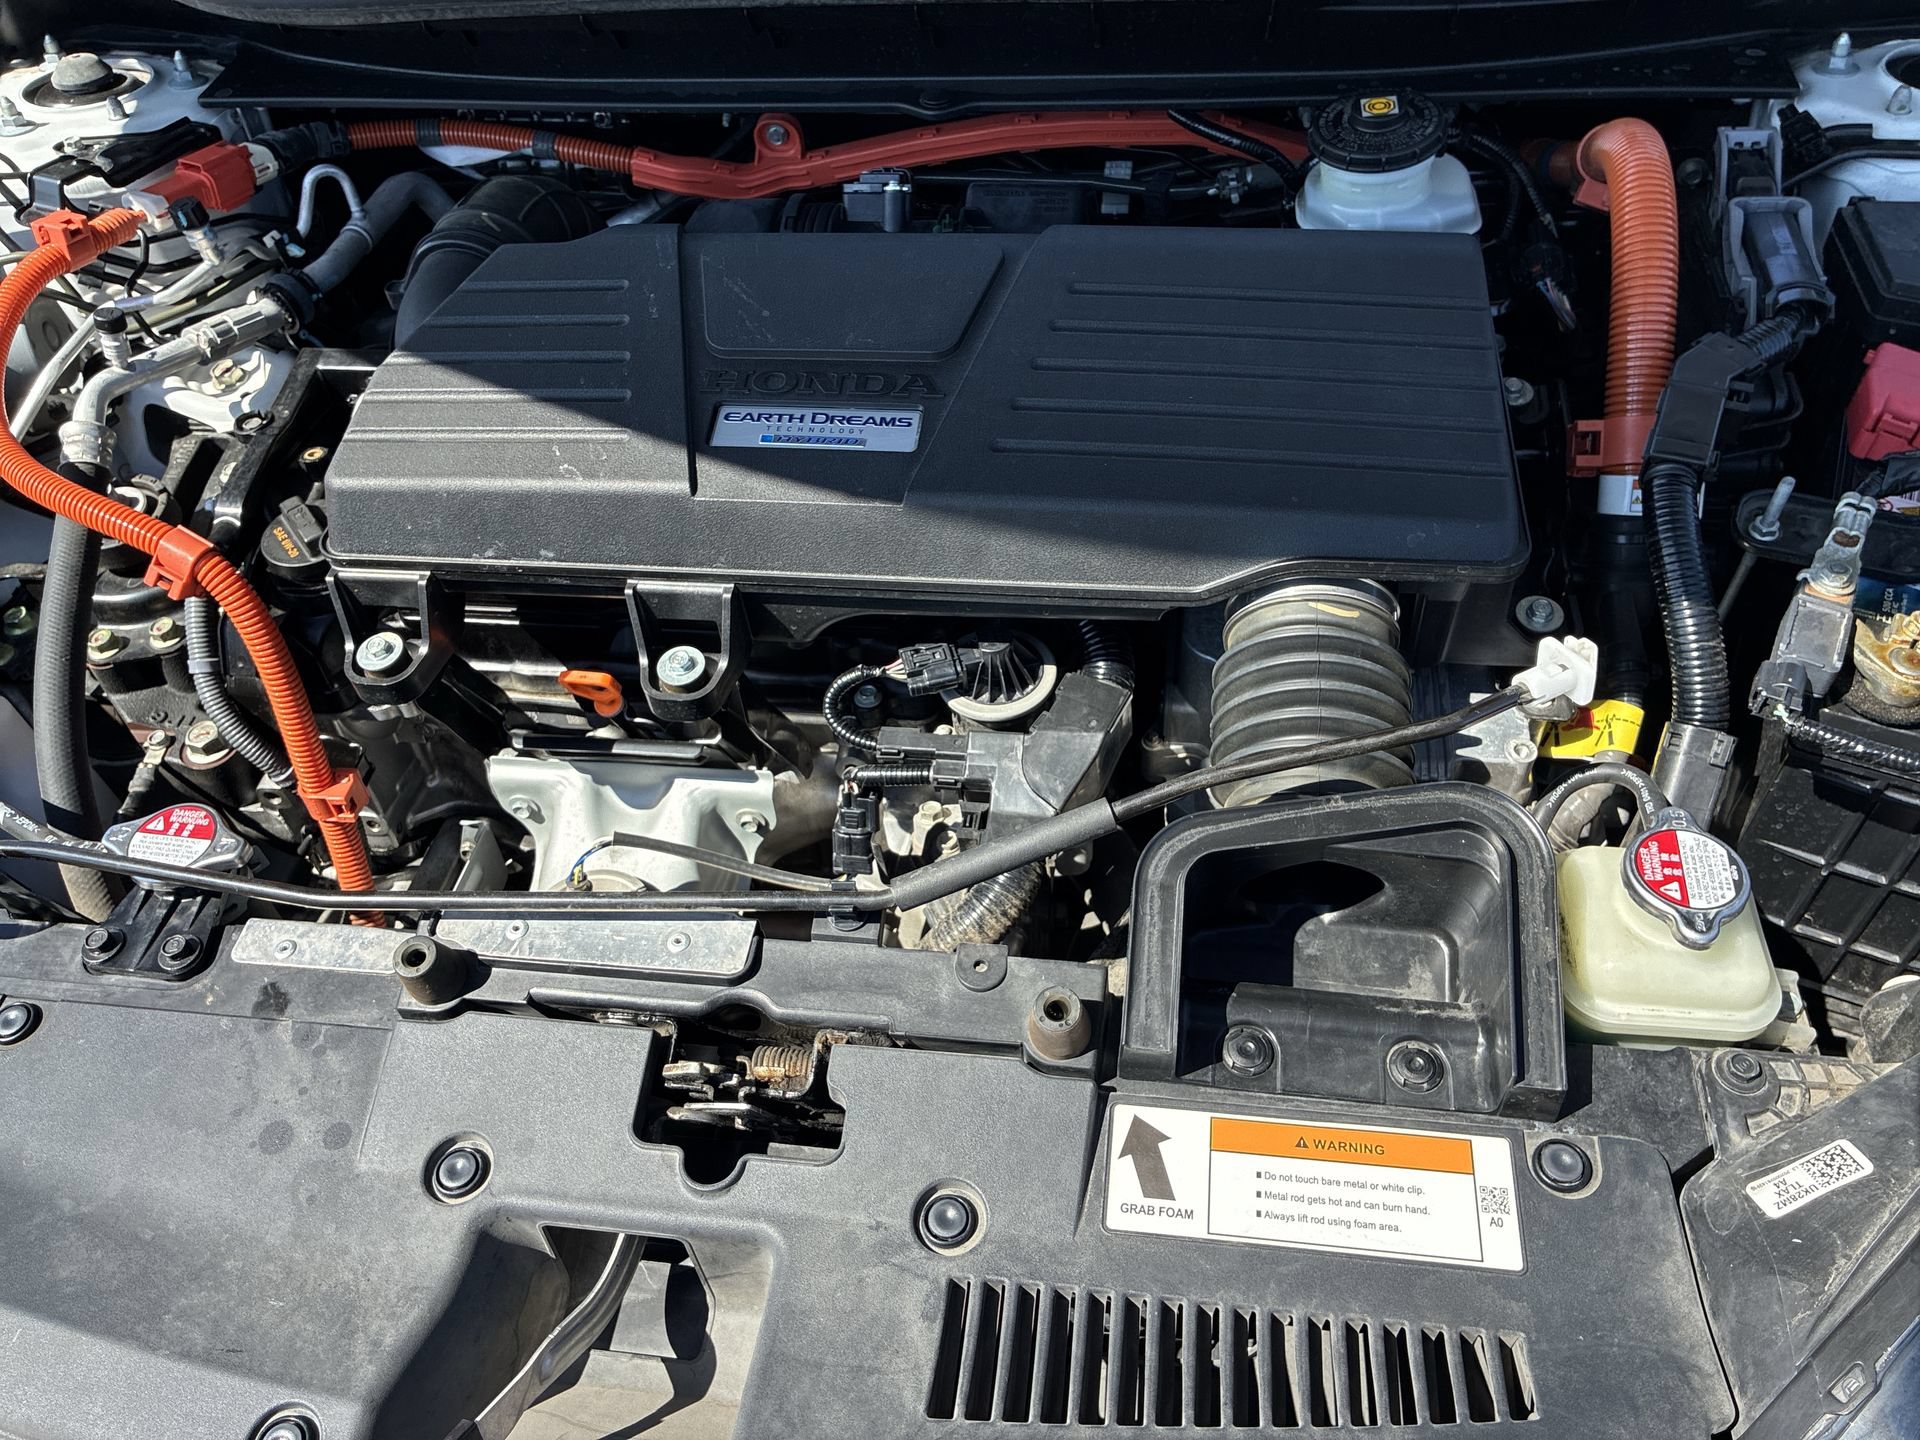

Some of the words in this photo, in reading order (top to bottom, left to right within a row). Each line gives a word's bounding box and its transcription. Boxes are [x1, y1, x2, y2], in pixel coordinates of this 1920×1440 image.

[700, 368, 945, 398] HONDA
[723, 411, 806, 424] EARTH
[811, 412, 913, 428] DREAMS
[766, 425, 865, 435] TECHNOLOGY
[775, 435, 863, 445] HYBRID
[174, 808, 208, 819] DANGER
[1669, 809, 1687, 828] 0.5
[1640, 847, 1654, 881] DANGER
[1648, 841, 1664, 881] WARNUNG
[1313, 1138, 1385, 1155] WARNING
[1264, 1172, 1276, 1180] Do
[1279, 1174, 1293, 1182] not
[1295, 1175, 1319, 1184] touch
[1321, 1177, 1341, 1186] bare
[1344, 1181, 1367, 1189] metal
[1381, 1184, 1404, 1192] white
[1407, 1185, 1425, 1195] clip.
[1773, 1177, 1787, 1190] A4
[1774, 1181, 1804, 1198] TLAX
[1120, 1203, 1155, 1215] GRAB
[1159, 1206, 1193, 1220] FOAM
[1264, 1191, 1288, 1201] Metal
[1291, 1194, 1305, 1202] rod
[1307, 1196, 1326, 1205] gets
[1329, 1196, 1342, 1206] hot
[1345, 1200, 1361, 1208] and
[1364, 1202, 1380, 1210] can
[1383, 1202, 1402, 1212] burn
[1405, 1204, 1430, 1215] hand.
[1264, 1210, 1295, 1223] Always
[1298, 1213, 1308, 1223] lift
[1311, 1216, 1325, 1224] rod
[1327, 1217, 1351, 1229] using
[1354, 1219, 1376, 1229] foam
[1379, 1223, 1402, 1232] area.
